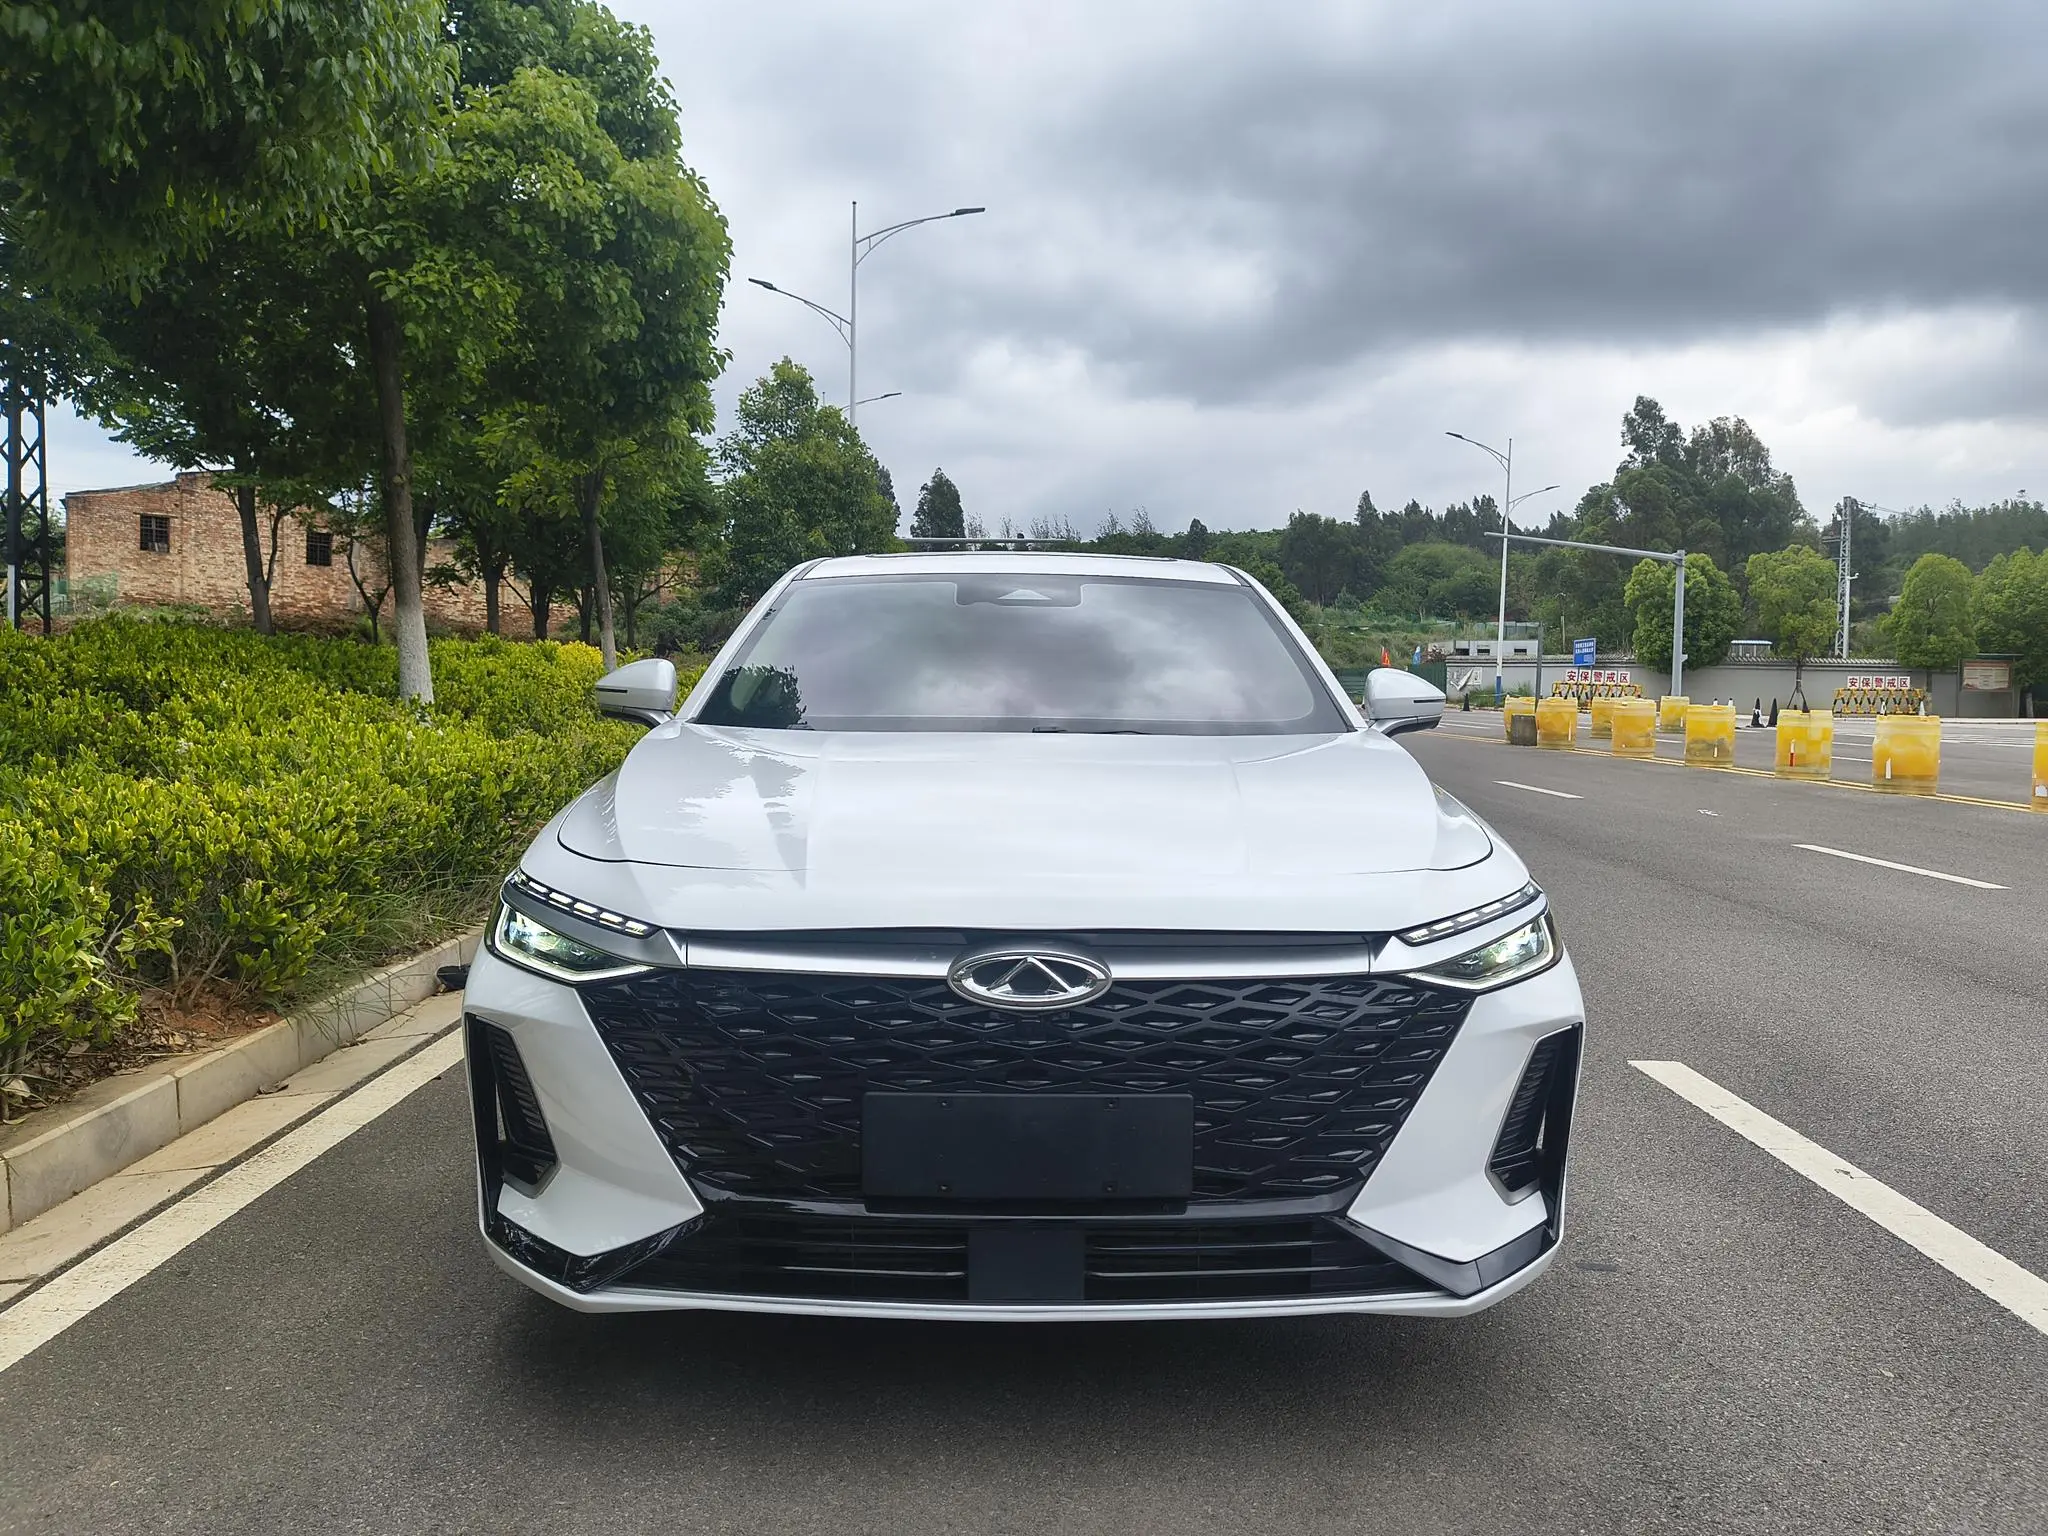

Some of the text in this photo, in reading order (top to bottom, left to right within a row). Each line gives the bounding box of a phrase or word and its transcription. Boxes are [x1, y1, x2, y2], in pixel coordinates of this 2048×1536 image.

[1566, 670, 1629, 683] 安保警戒区
[1848, 677, 1909, 688] 安保警戒区
